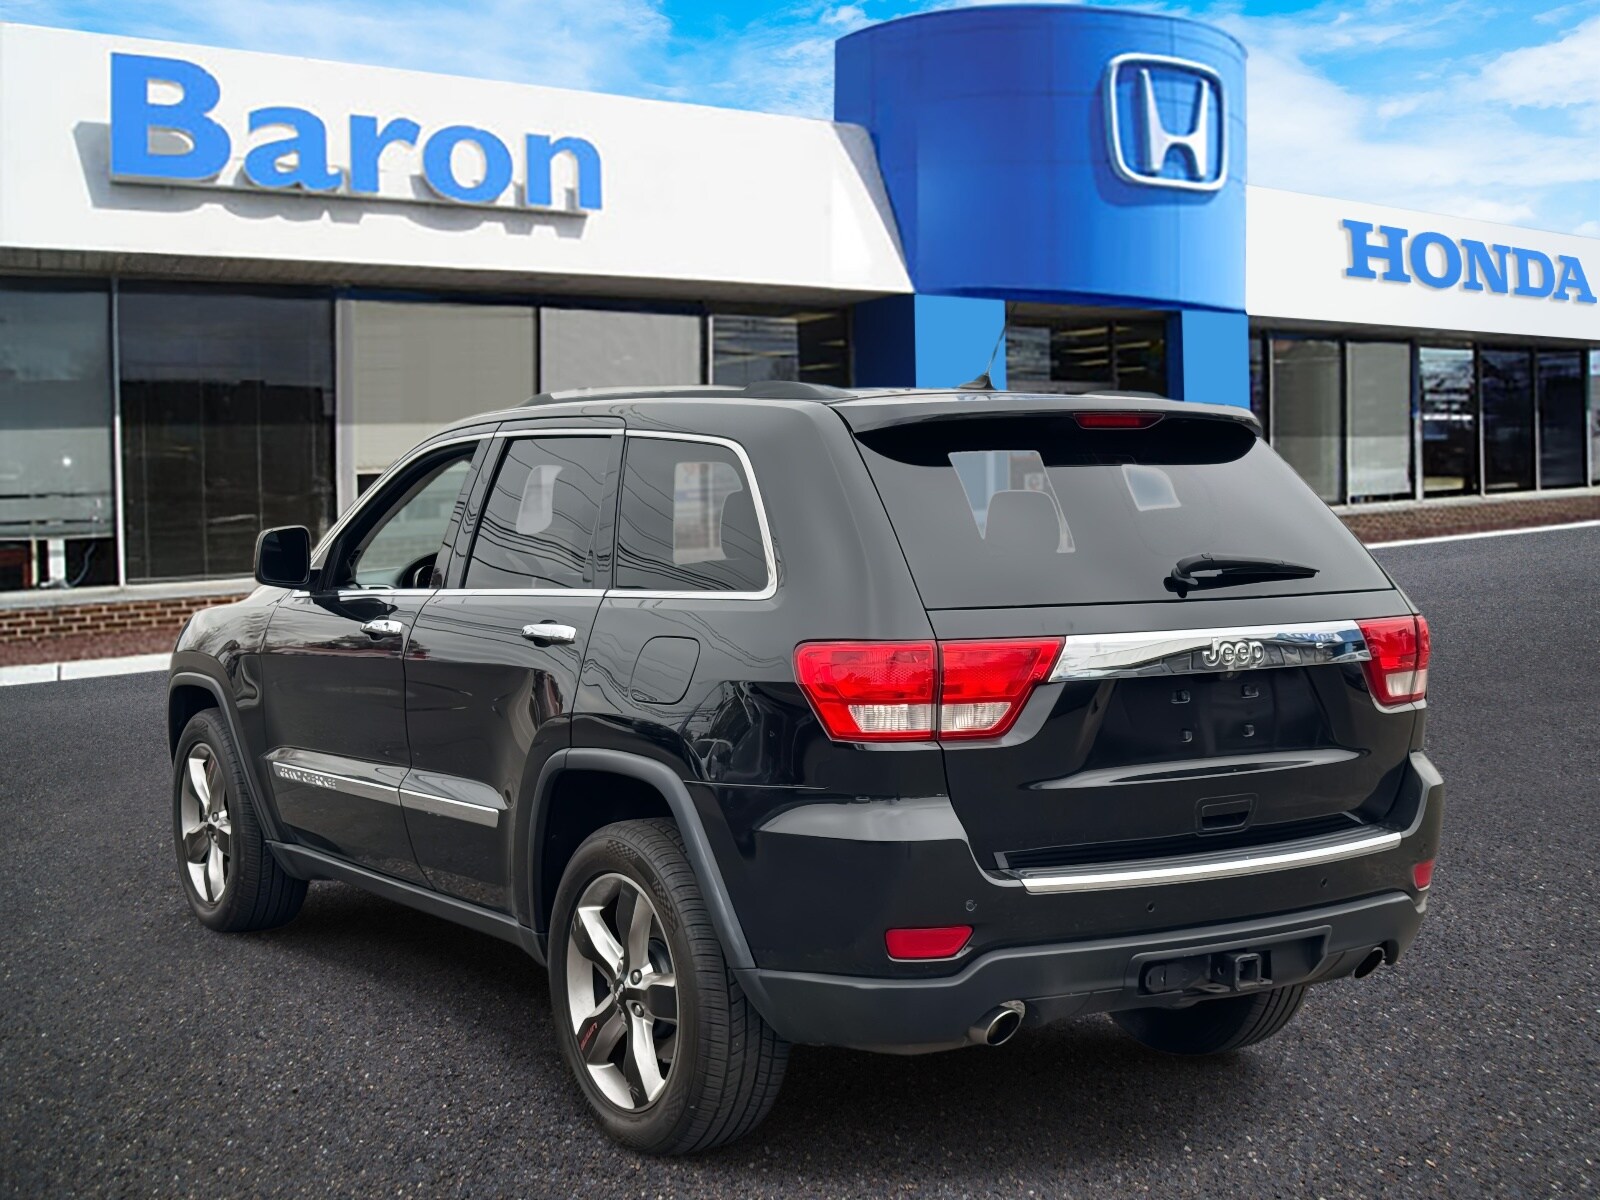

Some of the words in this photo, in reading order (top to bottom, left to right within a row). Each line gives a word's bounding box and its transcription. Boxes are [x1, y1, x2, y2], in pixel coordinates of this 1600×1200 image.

[110, 52, 602, 210] Baron
[1342, 218, 1598, 304] HONDA
[1202, 637, 1264, 668] Jeep
